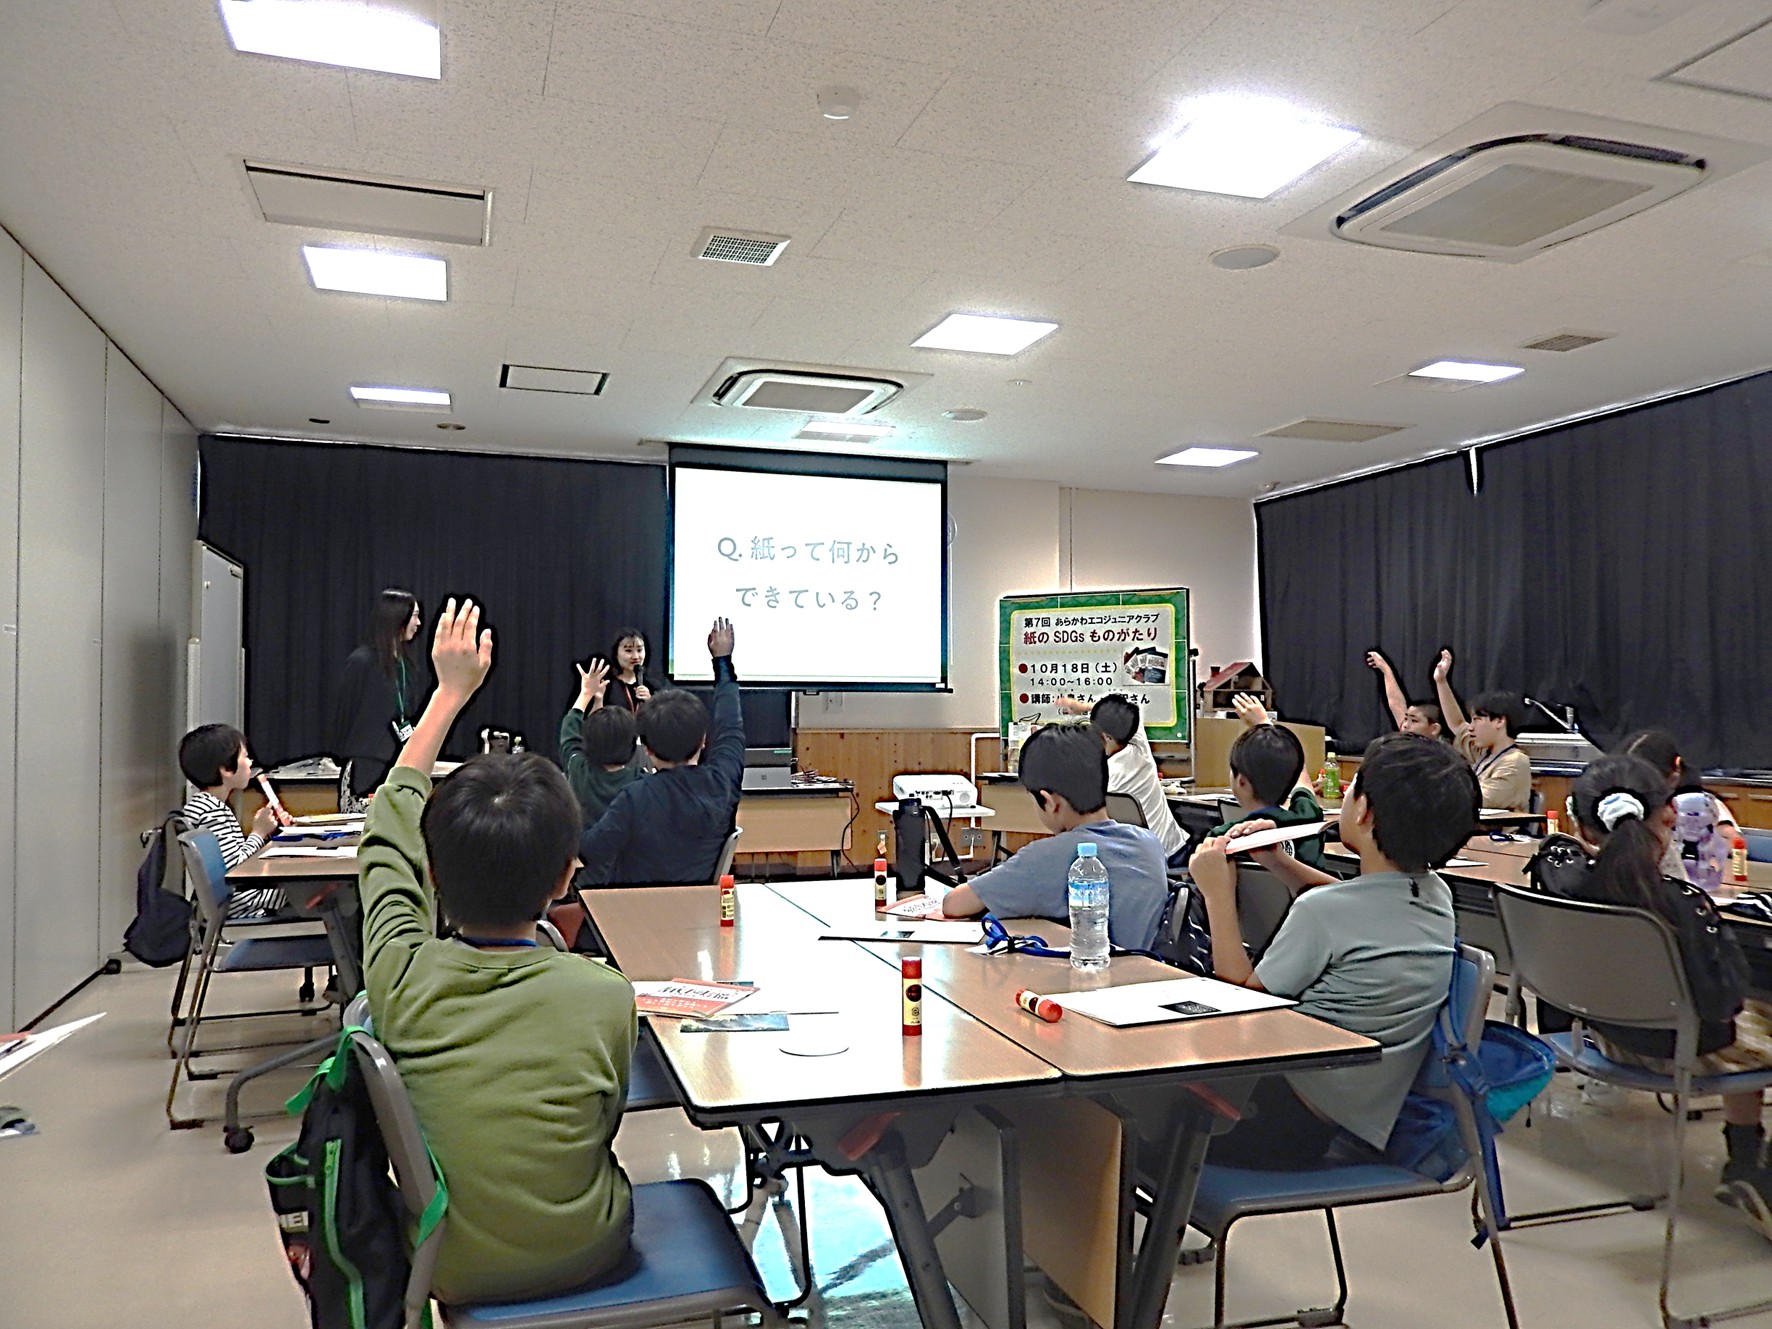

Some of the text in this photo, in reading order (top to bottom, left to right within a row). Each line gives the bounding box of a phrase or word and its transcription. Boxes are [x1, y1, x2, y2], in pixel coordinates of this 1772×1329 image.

[735, 585, 882, 611] できている？
